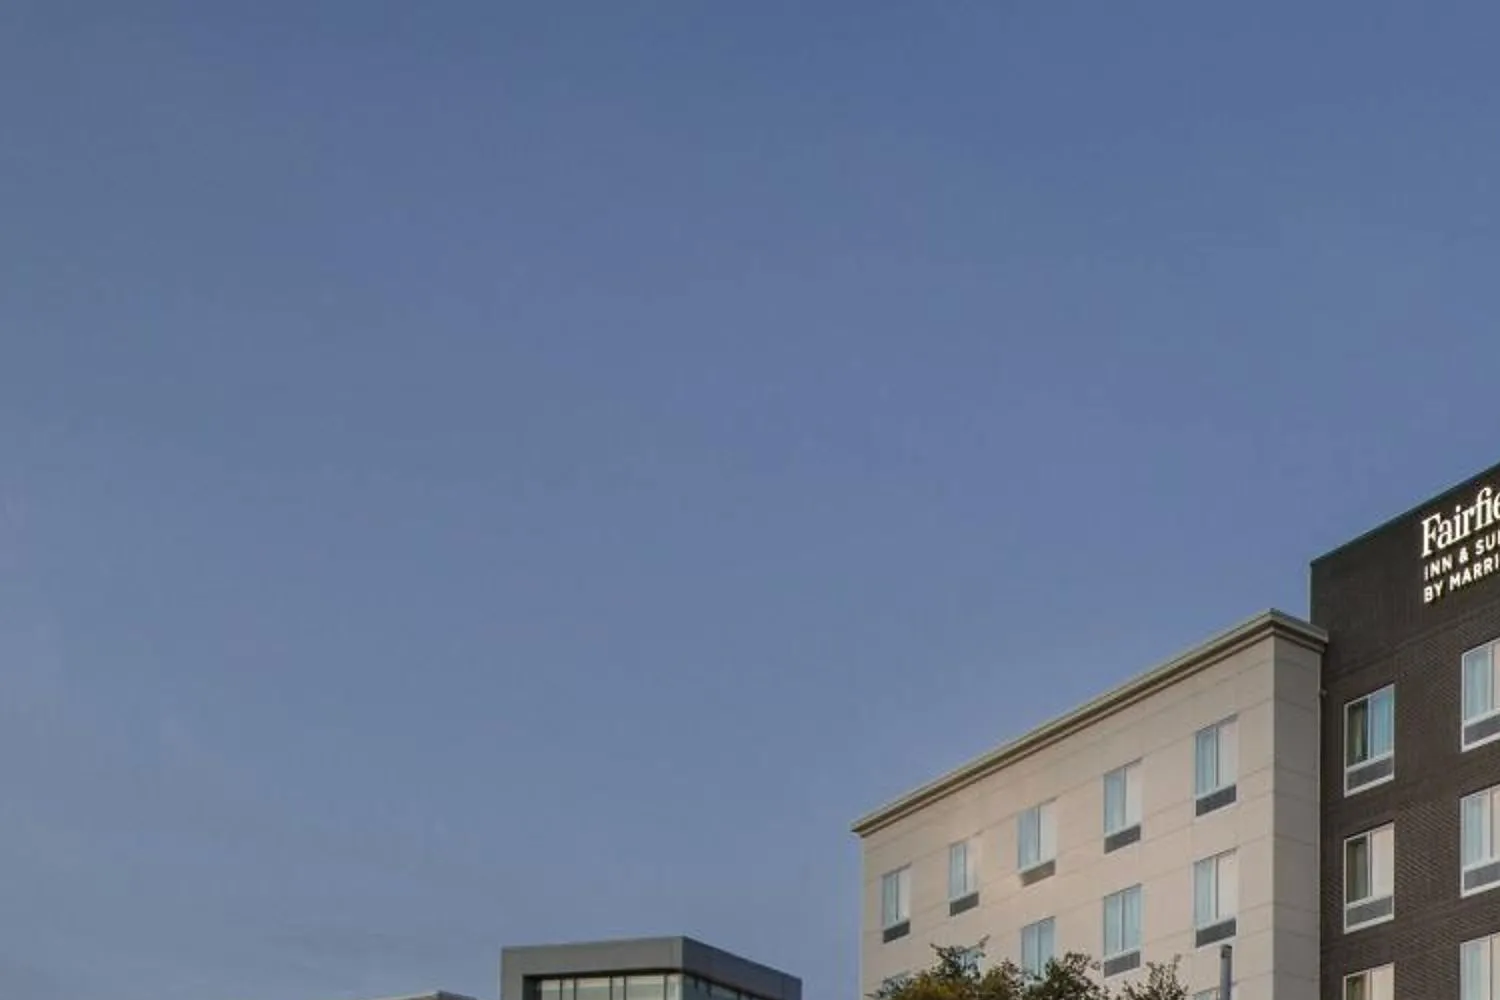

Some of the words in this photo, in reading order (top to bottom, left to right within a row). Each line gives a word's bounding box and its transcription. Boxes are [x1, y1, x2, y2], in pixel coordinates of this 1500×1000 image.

[1424, 554, 1453, 581] INN
[1459, 547, 1469, 564] &
[1423, 579, 1445, 604] BY
